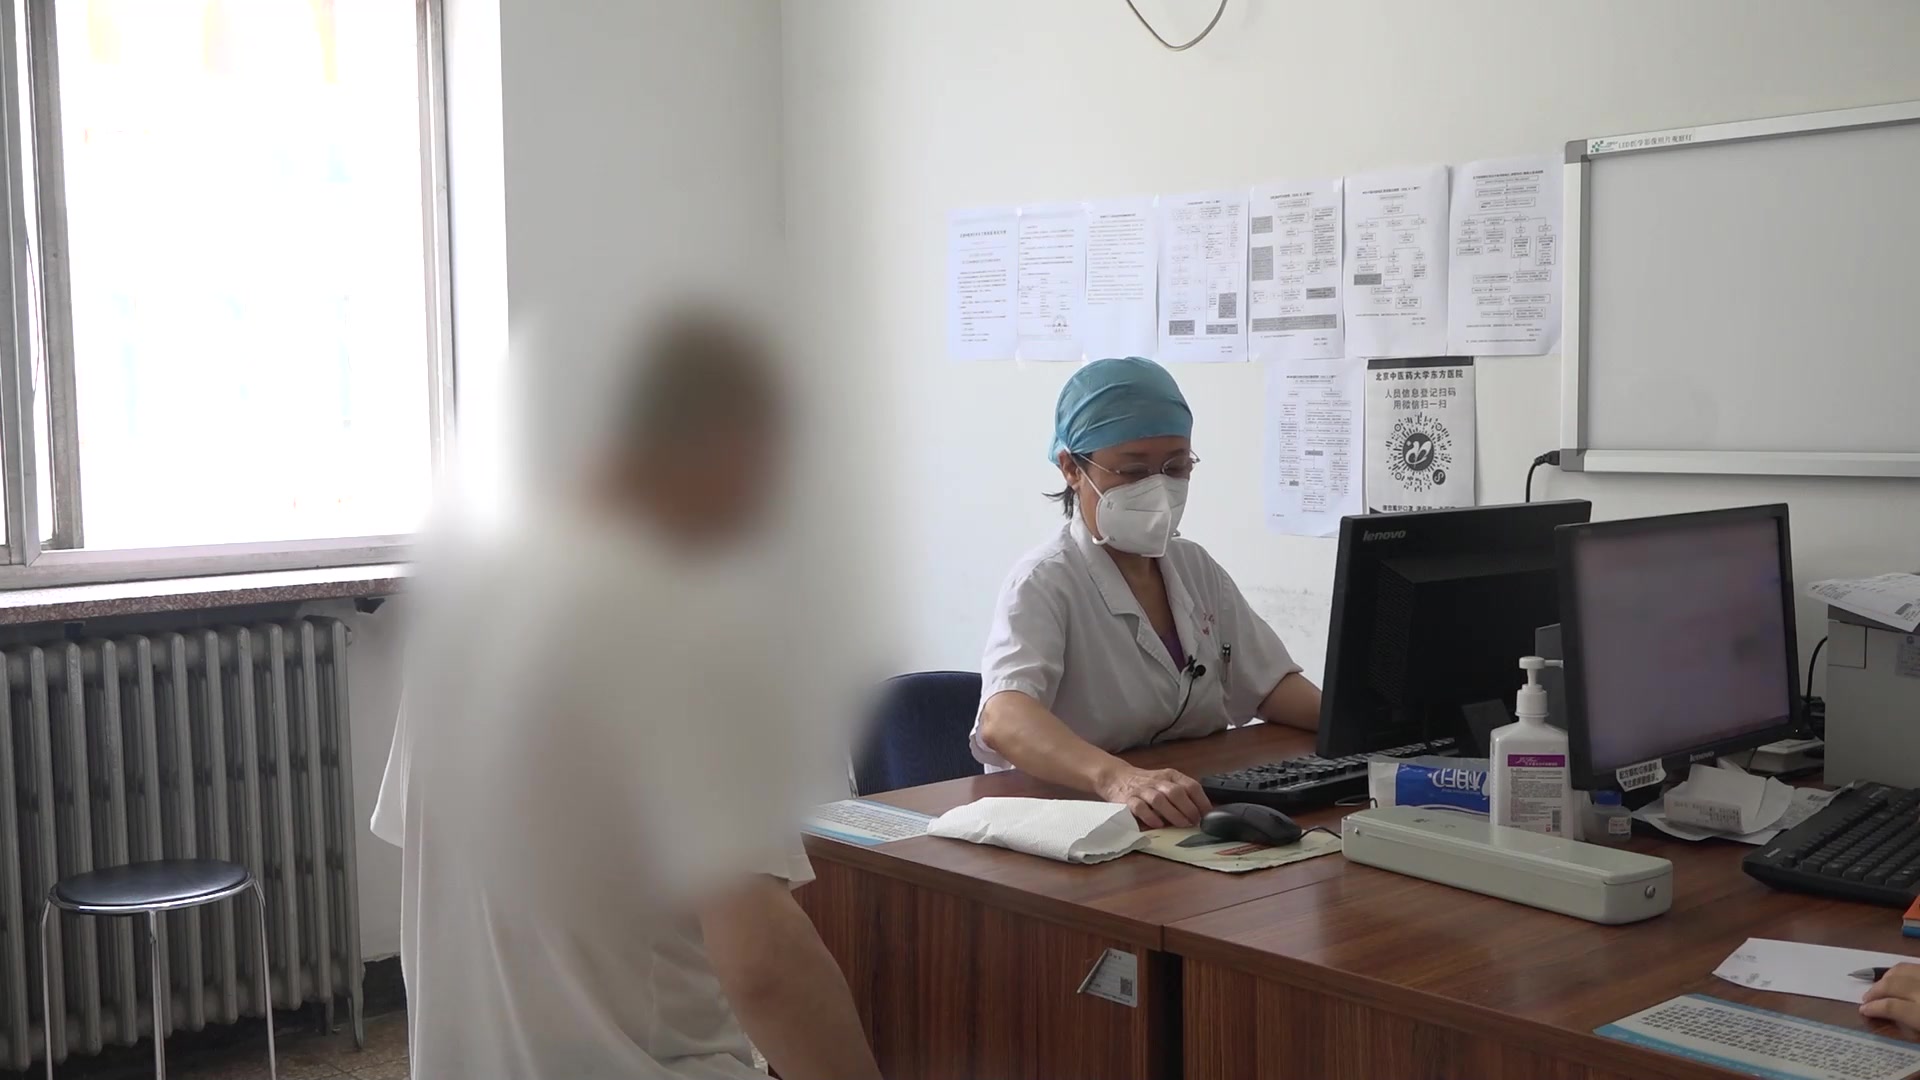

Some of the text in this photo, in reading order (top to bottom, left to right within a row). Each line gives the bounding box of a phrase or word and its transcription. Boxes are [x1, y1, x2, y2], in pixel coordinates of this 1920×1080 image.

[1375, 369, 1463, 381] 北京中医药大学东方医院
[1385, 387, 1456, 399] 人员信息登记扫码
[1393, 399, 1447, 410] 用微信扫一扫
[1362, 530, 1406, 542] lenovo
